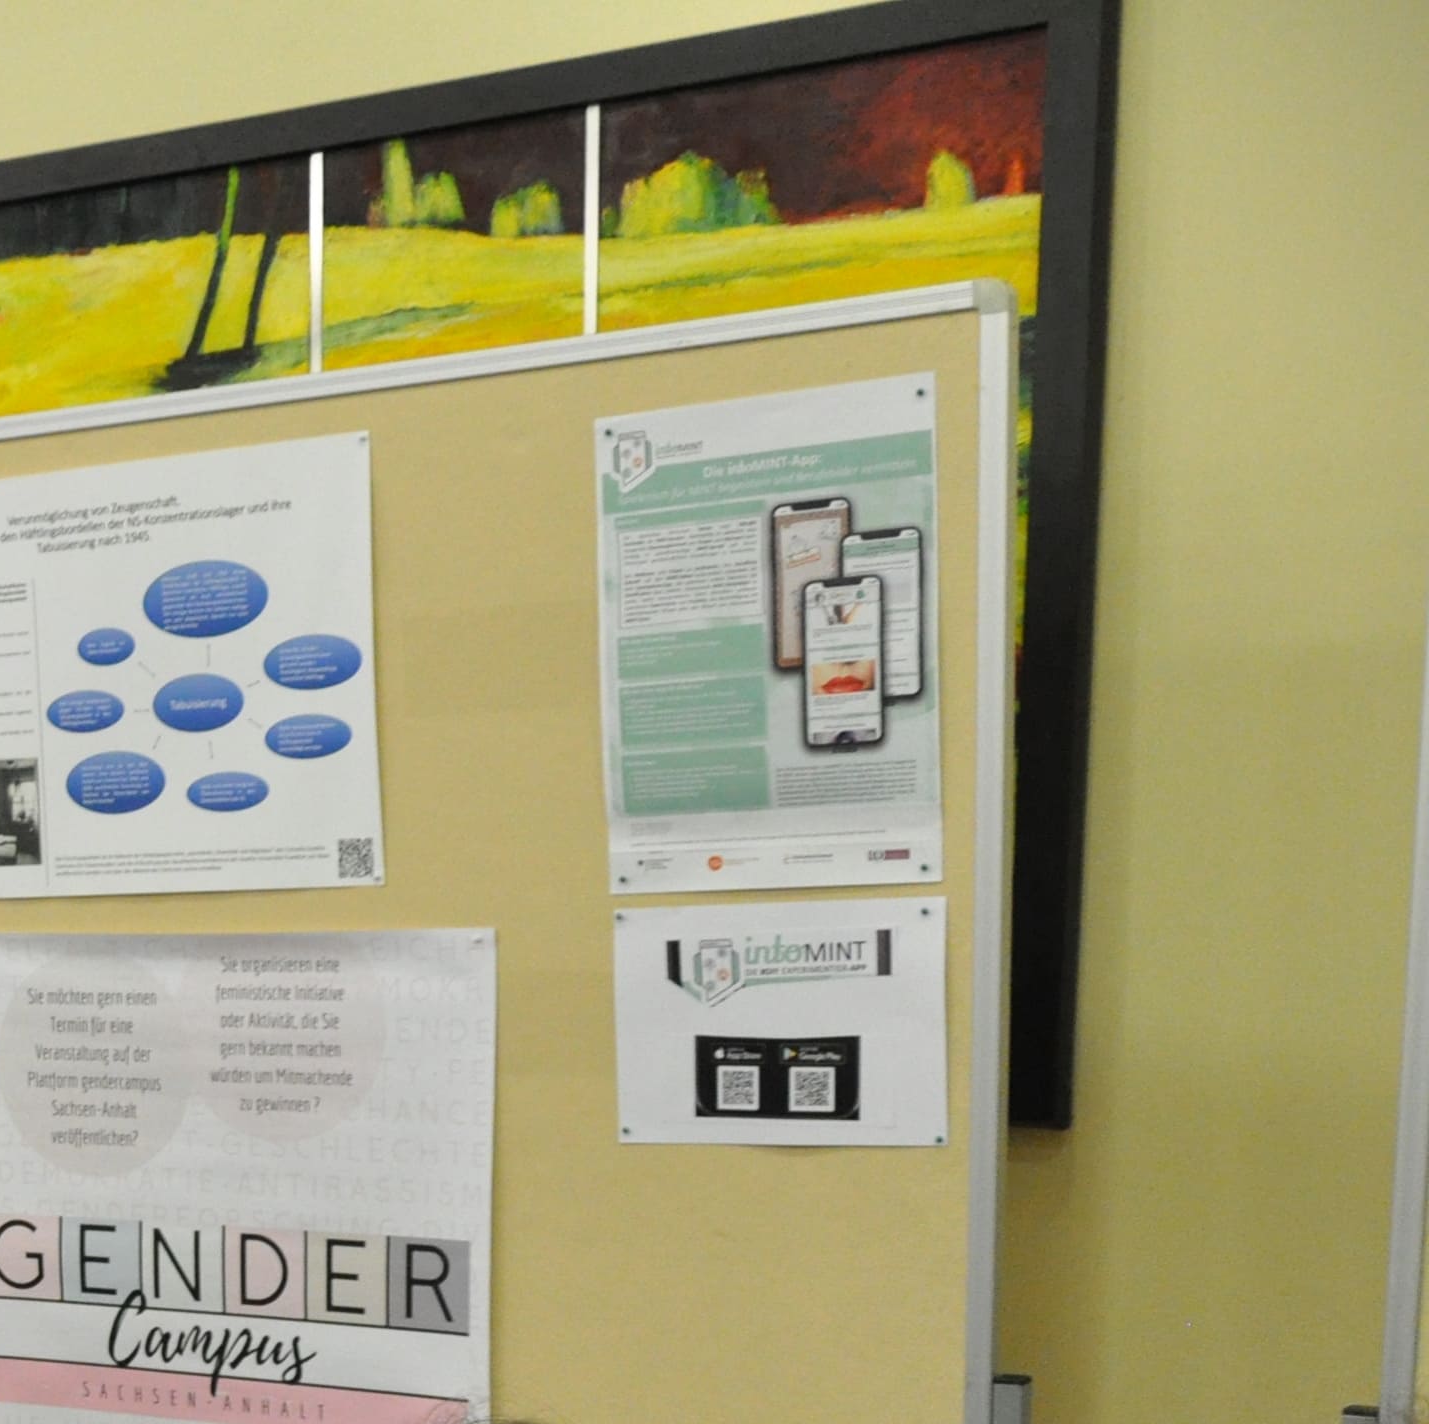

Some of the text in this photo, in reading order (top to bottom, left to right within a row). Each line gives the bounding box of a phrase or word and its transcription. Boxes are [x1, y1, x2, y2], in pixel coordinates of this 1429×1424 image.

[248, 500, 269, 514] und
[220, 956, 340, 976] Sie organisieren eine
[27, 988, 158, 1009] Sie möchten gern einen
[216, 984, 345, 1003] feministische Initiative
[50, 1016, 134, 1037] Termin für eine
[220, 1012, 341, 1030] oder Aktivität, die Sie
[34, 1044, 151, 1066] Veranstaltung auf der
[220, 1040, 341, 1060] gern bekannt machen
[27, 1071, 162, 1094] Plattform gendercampus
[210, 1068, 354, 1087] würden um Mitmachende
[52, 1100, 137, 1119] Sachsen-Anhalt
[240, 1096, 321, 1115] zu gewinnen ?
[50, 1128, 139, 1149] veröffentlichen?
[107, 1290, 317, 1395] Campus
[81, 1380, 328, 1422] SACHSEN-ANHALT
